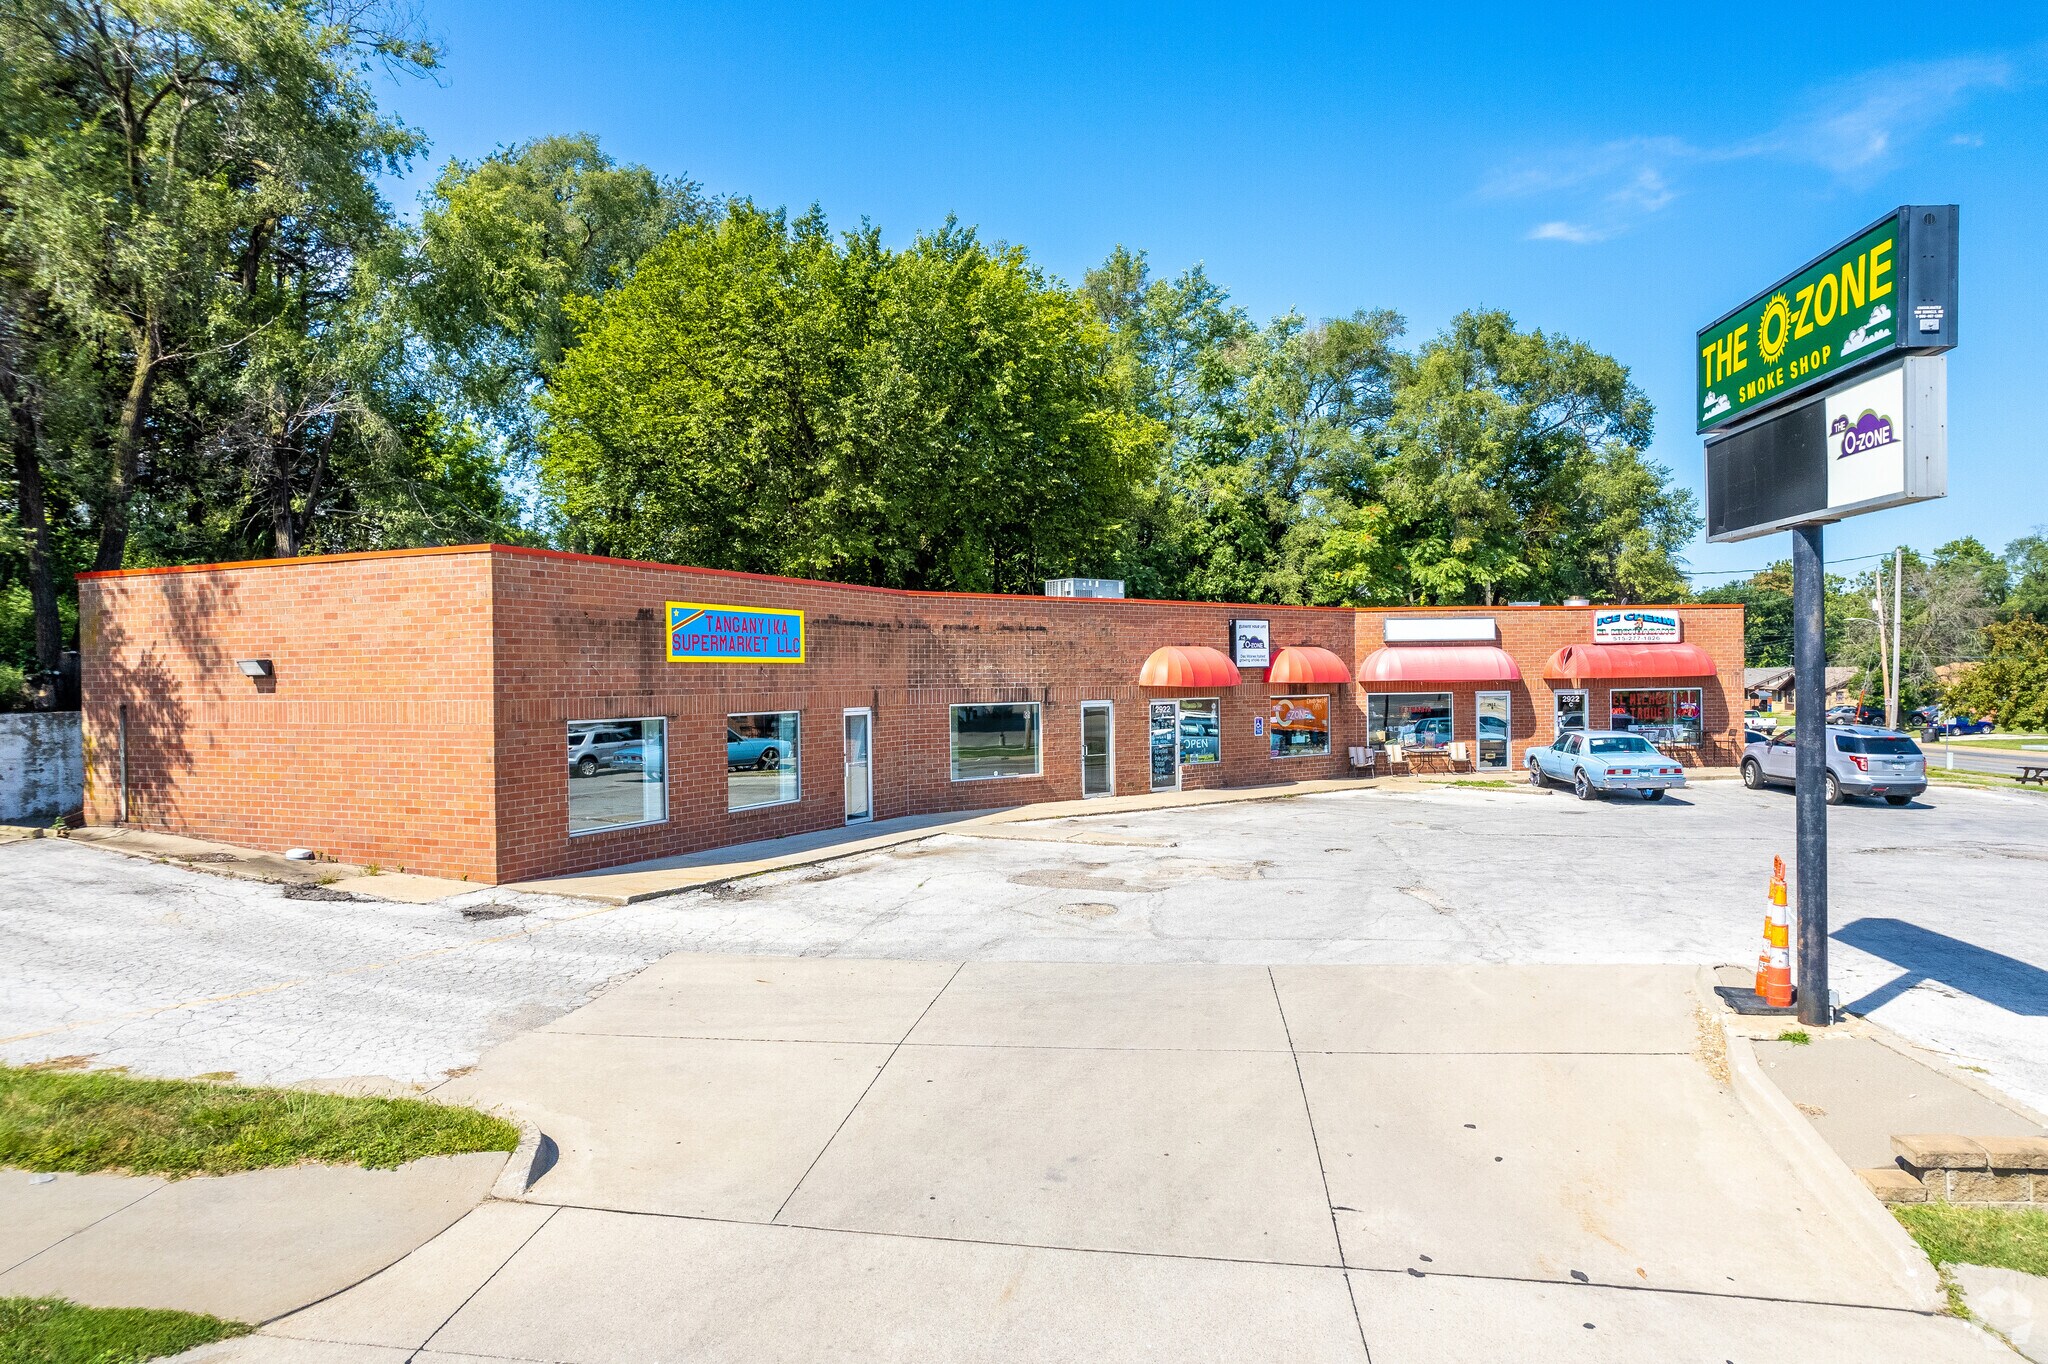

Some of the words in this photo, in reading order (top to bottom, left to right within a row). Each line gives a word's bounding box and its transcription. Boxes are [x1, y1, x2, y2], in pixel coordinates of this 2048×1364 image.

[1702, 323, 1748, 388] THE
[1760, 239, 1892, 358] O-ZONE
[1739, 367, 1784, 403] SMOKE
[1790, 345, 1831, 379] SHOP
[1834, 420, 1846, 433] THE
[1845, 425, 1890, 454] O-ZONE
[705, 615, 788, 635] TANGANYIKA
[1597, 614, 1620, 627] ICE
[672, 634, 769, 653] SUPERMARKET
[777, 637, 800, 653] LLC
[1154, 705, 1171, 714] 2922
[1183, 738, 1209, 749] OPEN
